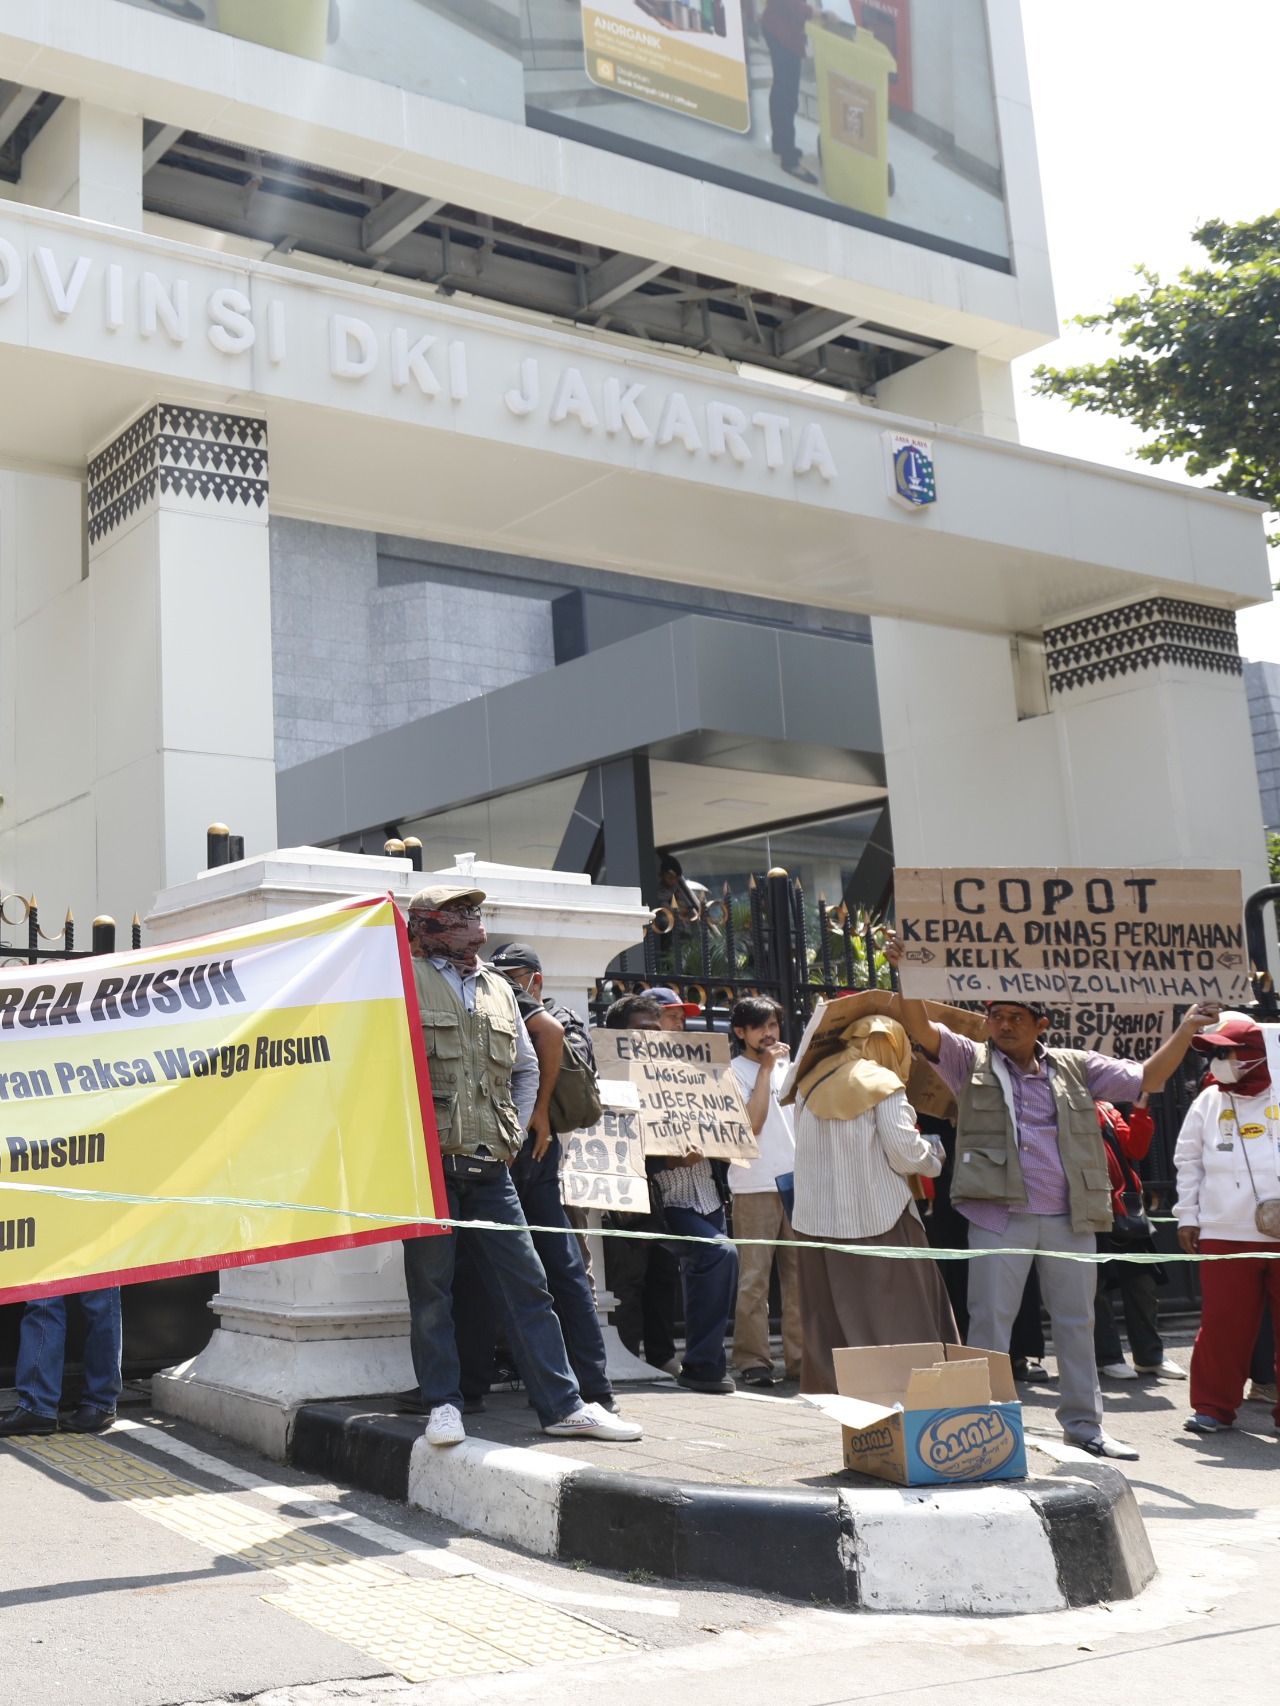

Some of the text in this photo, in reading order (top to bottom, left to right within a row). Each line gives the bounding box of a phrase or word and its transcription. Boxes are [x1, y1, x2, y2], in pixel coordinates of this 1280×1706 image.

[593, 16, 662, 50] ANORGANIK
[329, 313, 469, 400] DKI
[504, 358, 839, 482] JAKARTA
[954, 878, 1158, 916] COPOT
[901, 918, 1243, 949] KEPALA DINAS PERUMAHAN
[945, 947, 1214, 972] KELIK INDRIYANTO
[89, 959, 247, 1022] RUSUN
[949, 973, 991, 992] YG.
[56, 1057, 156, 1092] Paksa
[154, 1041, 251, 1081] Warga
[254, 1034, 331, 1069] Rusun
[647, 1120, 752, 1146] TUTUP MATA
[663, 1110, 718, 1122] JANGAN
[6, 1131, 106, 1173] Rusun
